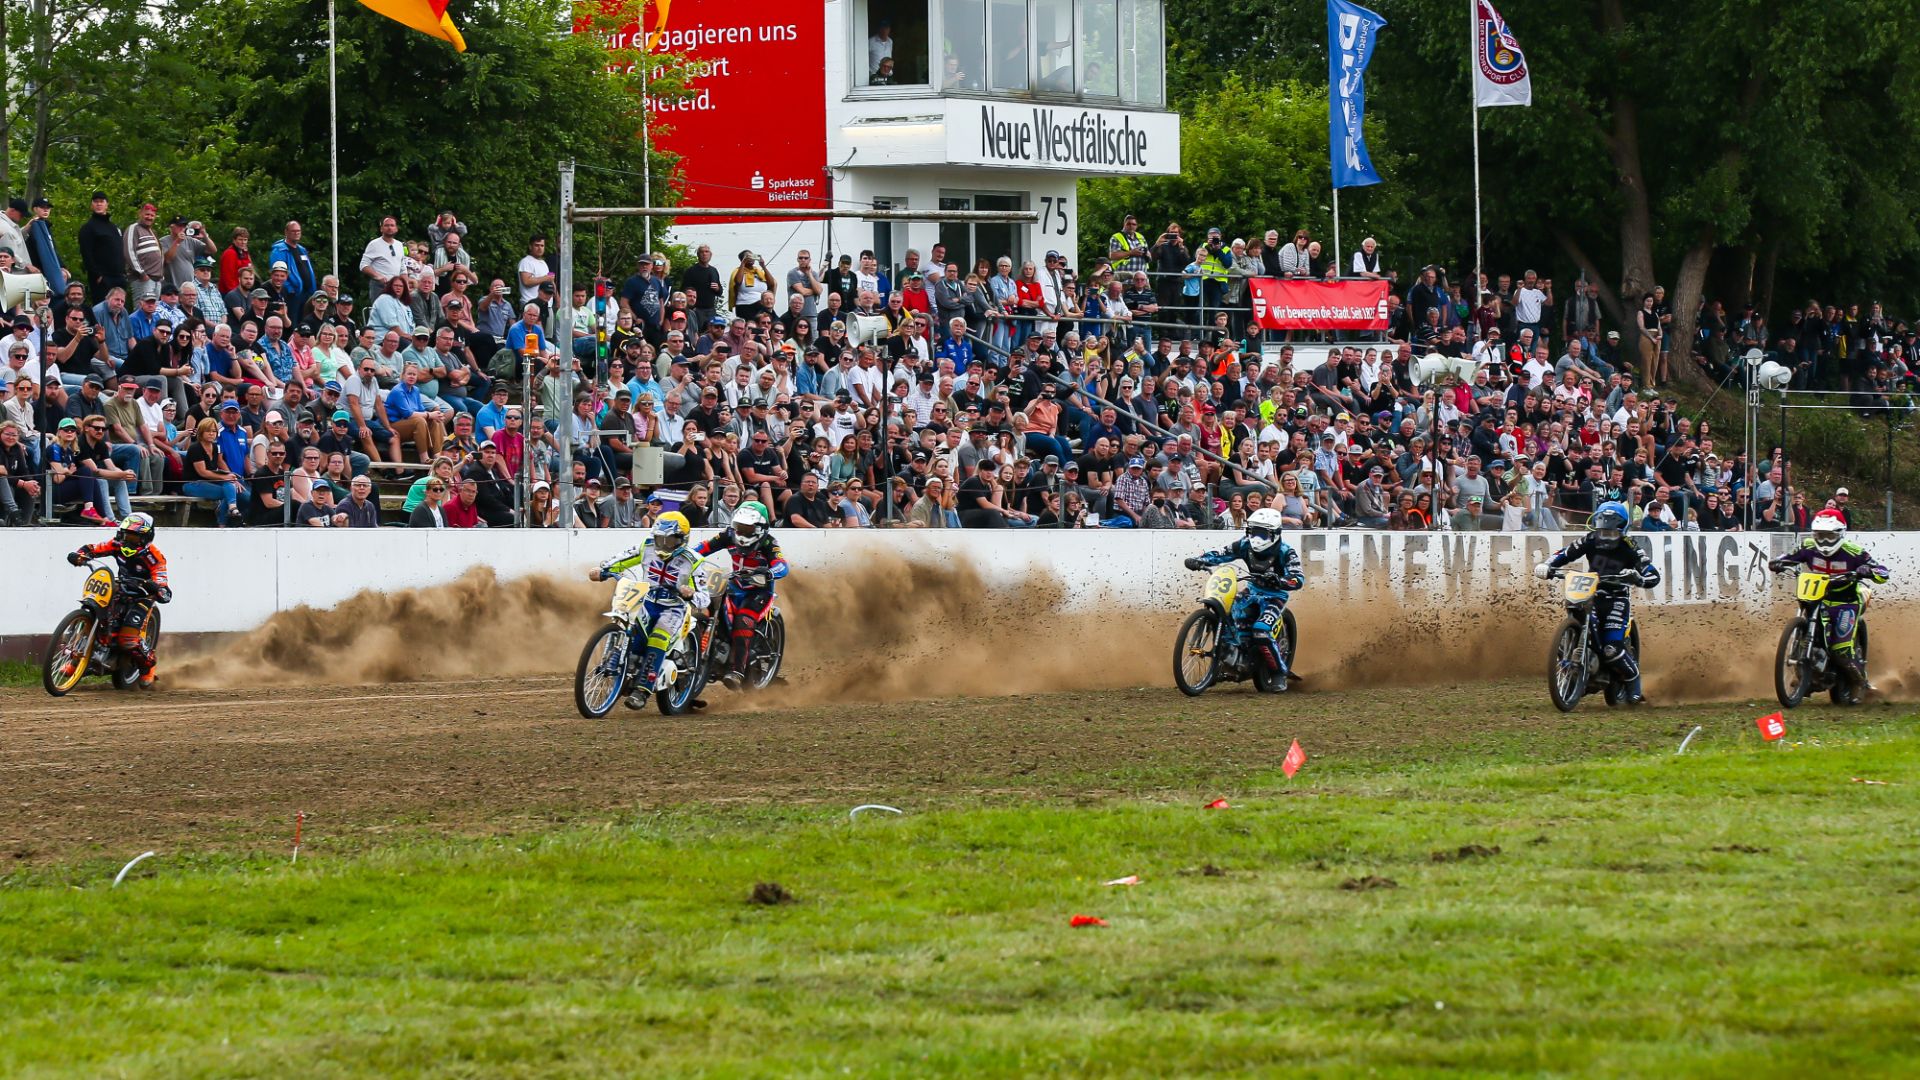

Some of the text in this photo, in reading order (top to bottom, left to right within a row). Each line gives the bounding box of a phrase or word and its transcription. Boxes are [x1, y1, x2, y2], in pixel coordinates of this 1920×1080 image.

[758, 24, 797, 42] uns
[1479, 38, 1507, 82] MOTORSPORT
[981, 104, 1148, 166] Neue Westfälische
[768, 177, 815, 190] Sparkasse
[768, 190, 809, 202] Bielefeld
[1040, 196, 1068, 236] 75
[1272, 304, 1286, 319] Wir
[1286, 304, 1320, 322] bewegen
[1320, 304, 1331, 319] die
[86, 578, 110, 597] 666
[1567, 575, 1596, 592] 92
[1803, 578, 1821, 597] 11
